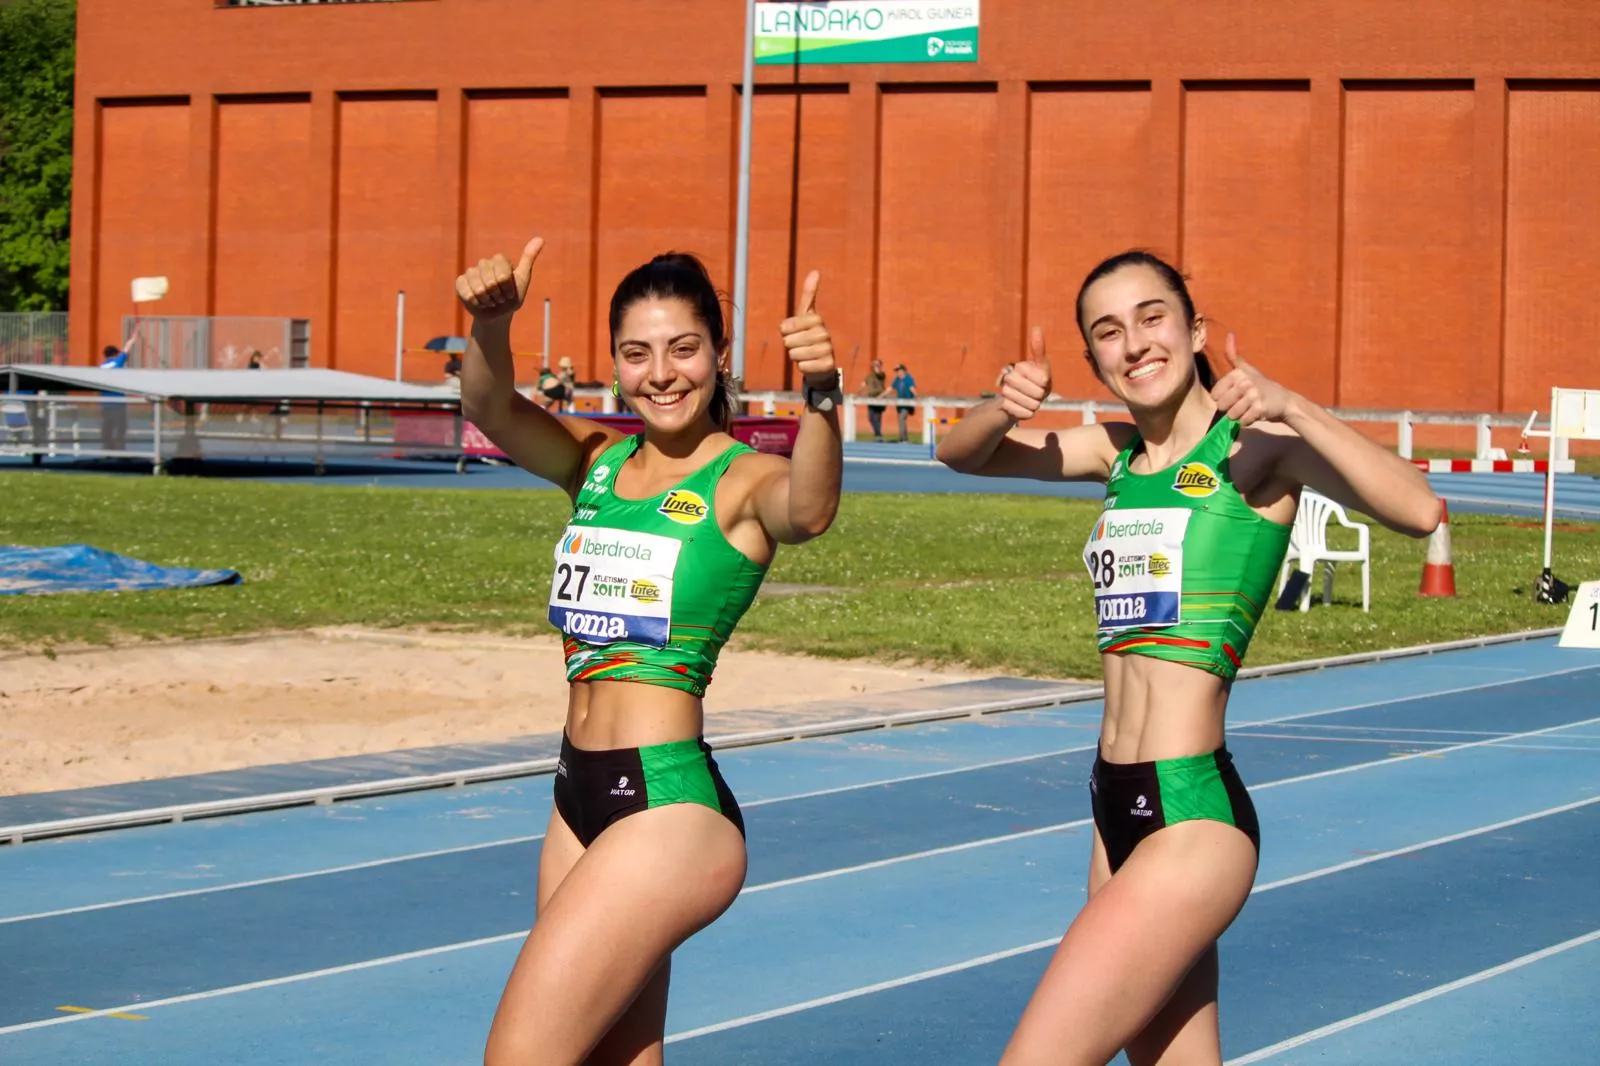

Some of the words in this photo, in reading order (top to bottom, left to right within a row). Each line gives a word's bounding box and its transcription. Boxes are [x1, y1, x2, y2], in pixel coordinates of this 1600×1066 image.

[761, 8, 883, 32] LANDAKO
[1106, 519, 1164, 538] Iberdrola
[582, 538, 652, 561] Iberdrola
[1090, 549, 1115, 589] 28
[1118, 562, 1145, 578] ZOITI
[557, 562, 591, 602] 27
[593, 574, 628, 584] ATLETISMO
[593, 583, 627, 598] ZOITI
[610, 788, 635, 796] VIATOR
